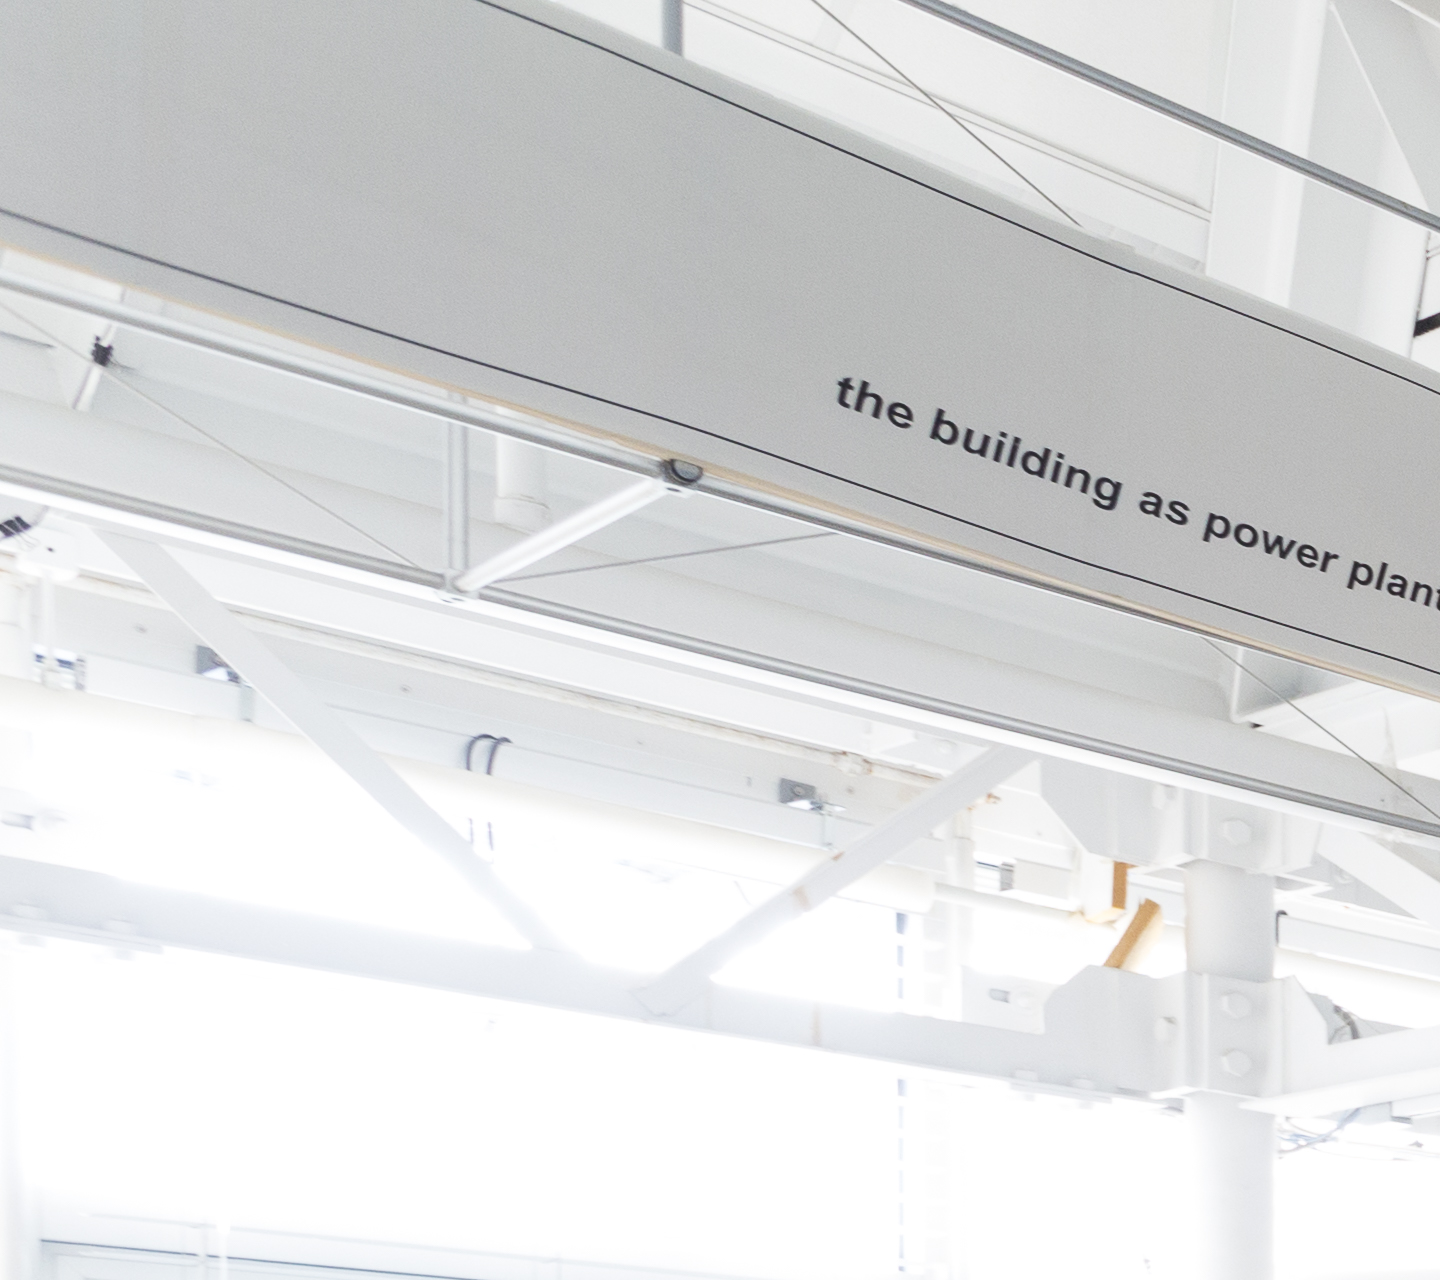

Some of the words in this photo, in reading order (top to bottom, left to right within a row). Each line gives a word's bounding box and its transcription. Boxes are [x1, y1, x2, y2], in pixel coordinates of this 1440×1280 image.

[836, 374, 916, 432] the
[931, 408, 1121, 511] building
[1138, 486, 1189, 528] as
[1203, 508, 1339, 575] power
